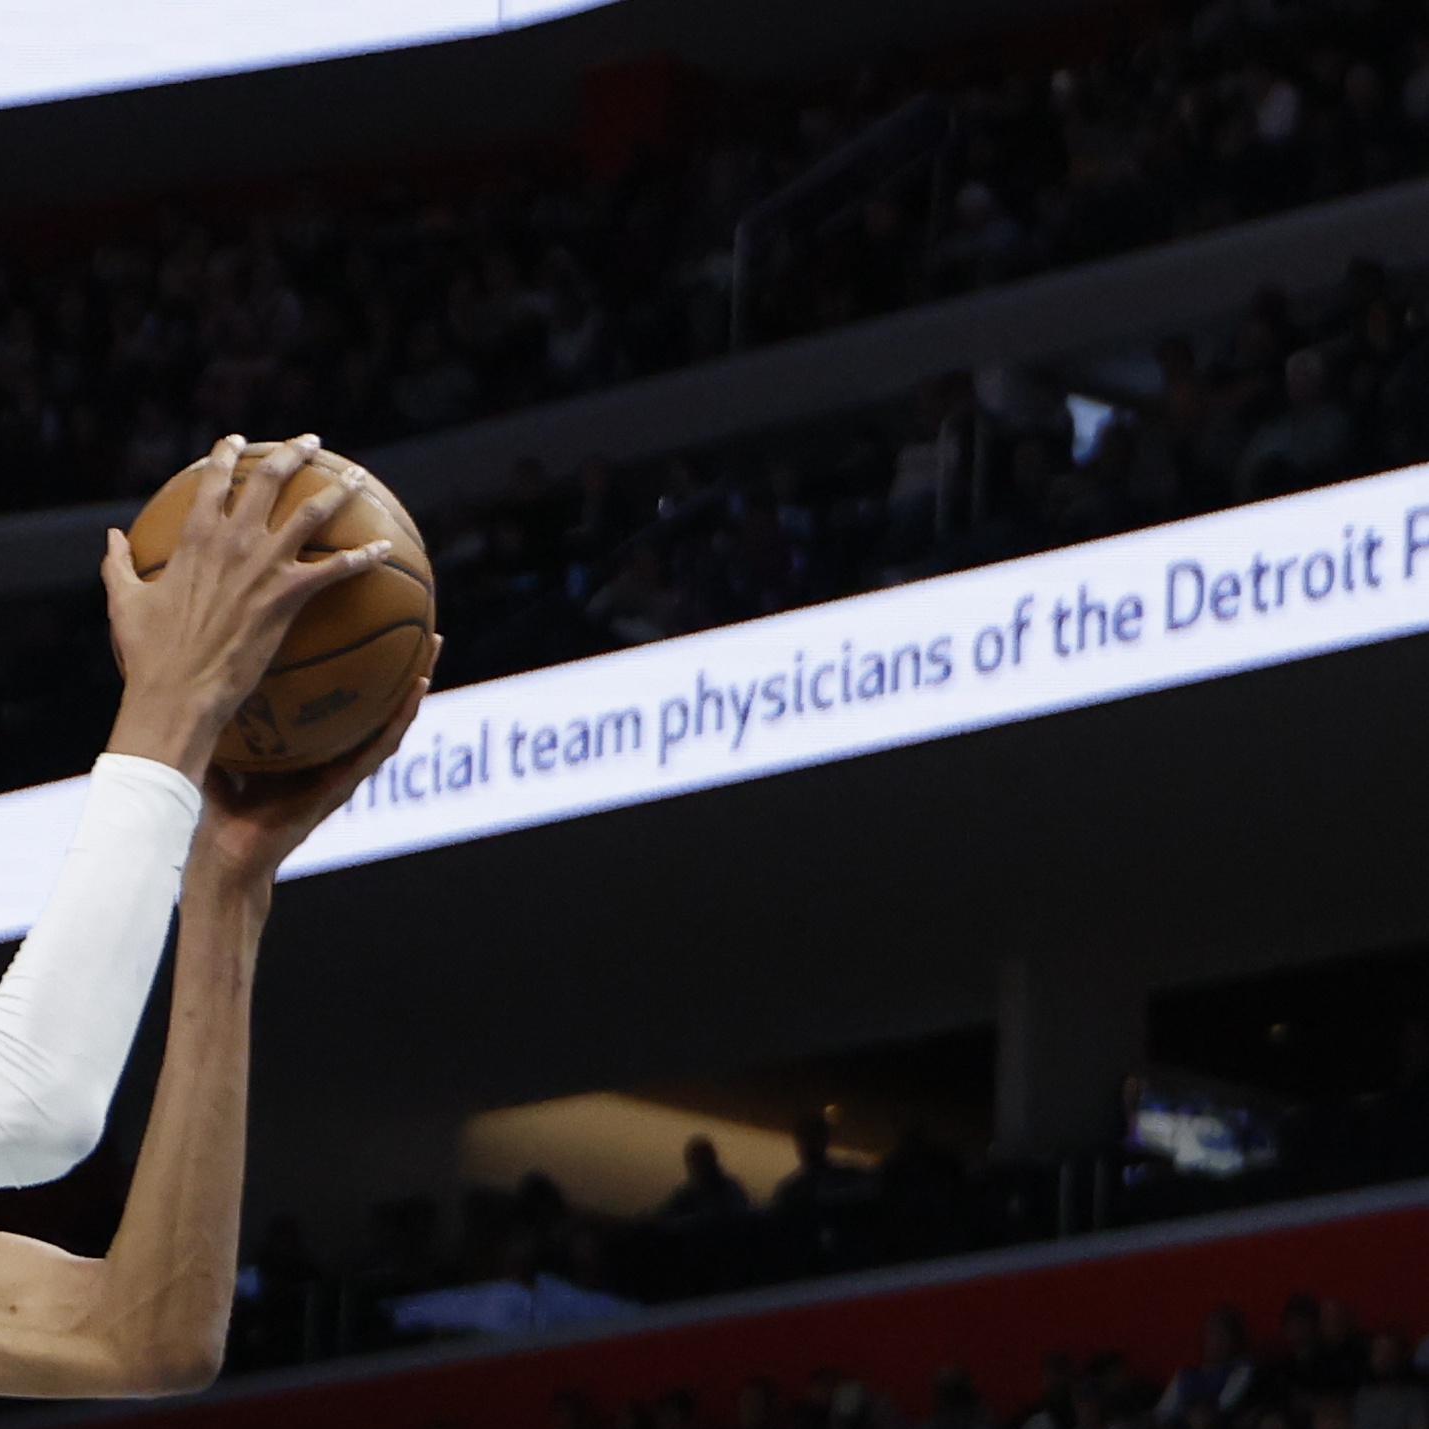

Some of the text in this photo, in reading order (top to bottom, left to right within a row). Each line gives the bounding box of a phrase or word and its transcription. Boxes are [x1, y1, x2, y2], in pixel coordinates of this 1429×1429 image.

[509, 705, 642, 777] team
[659, 632, 953, 766] physicians
[973, 593, 1034, 675] of
[1052, 582, 1144, 656] the
[1165, 523, 1383, 633] Detroit
